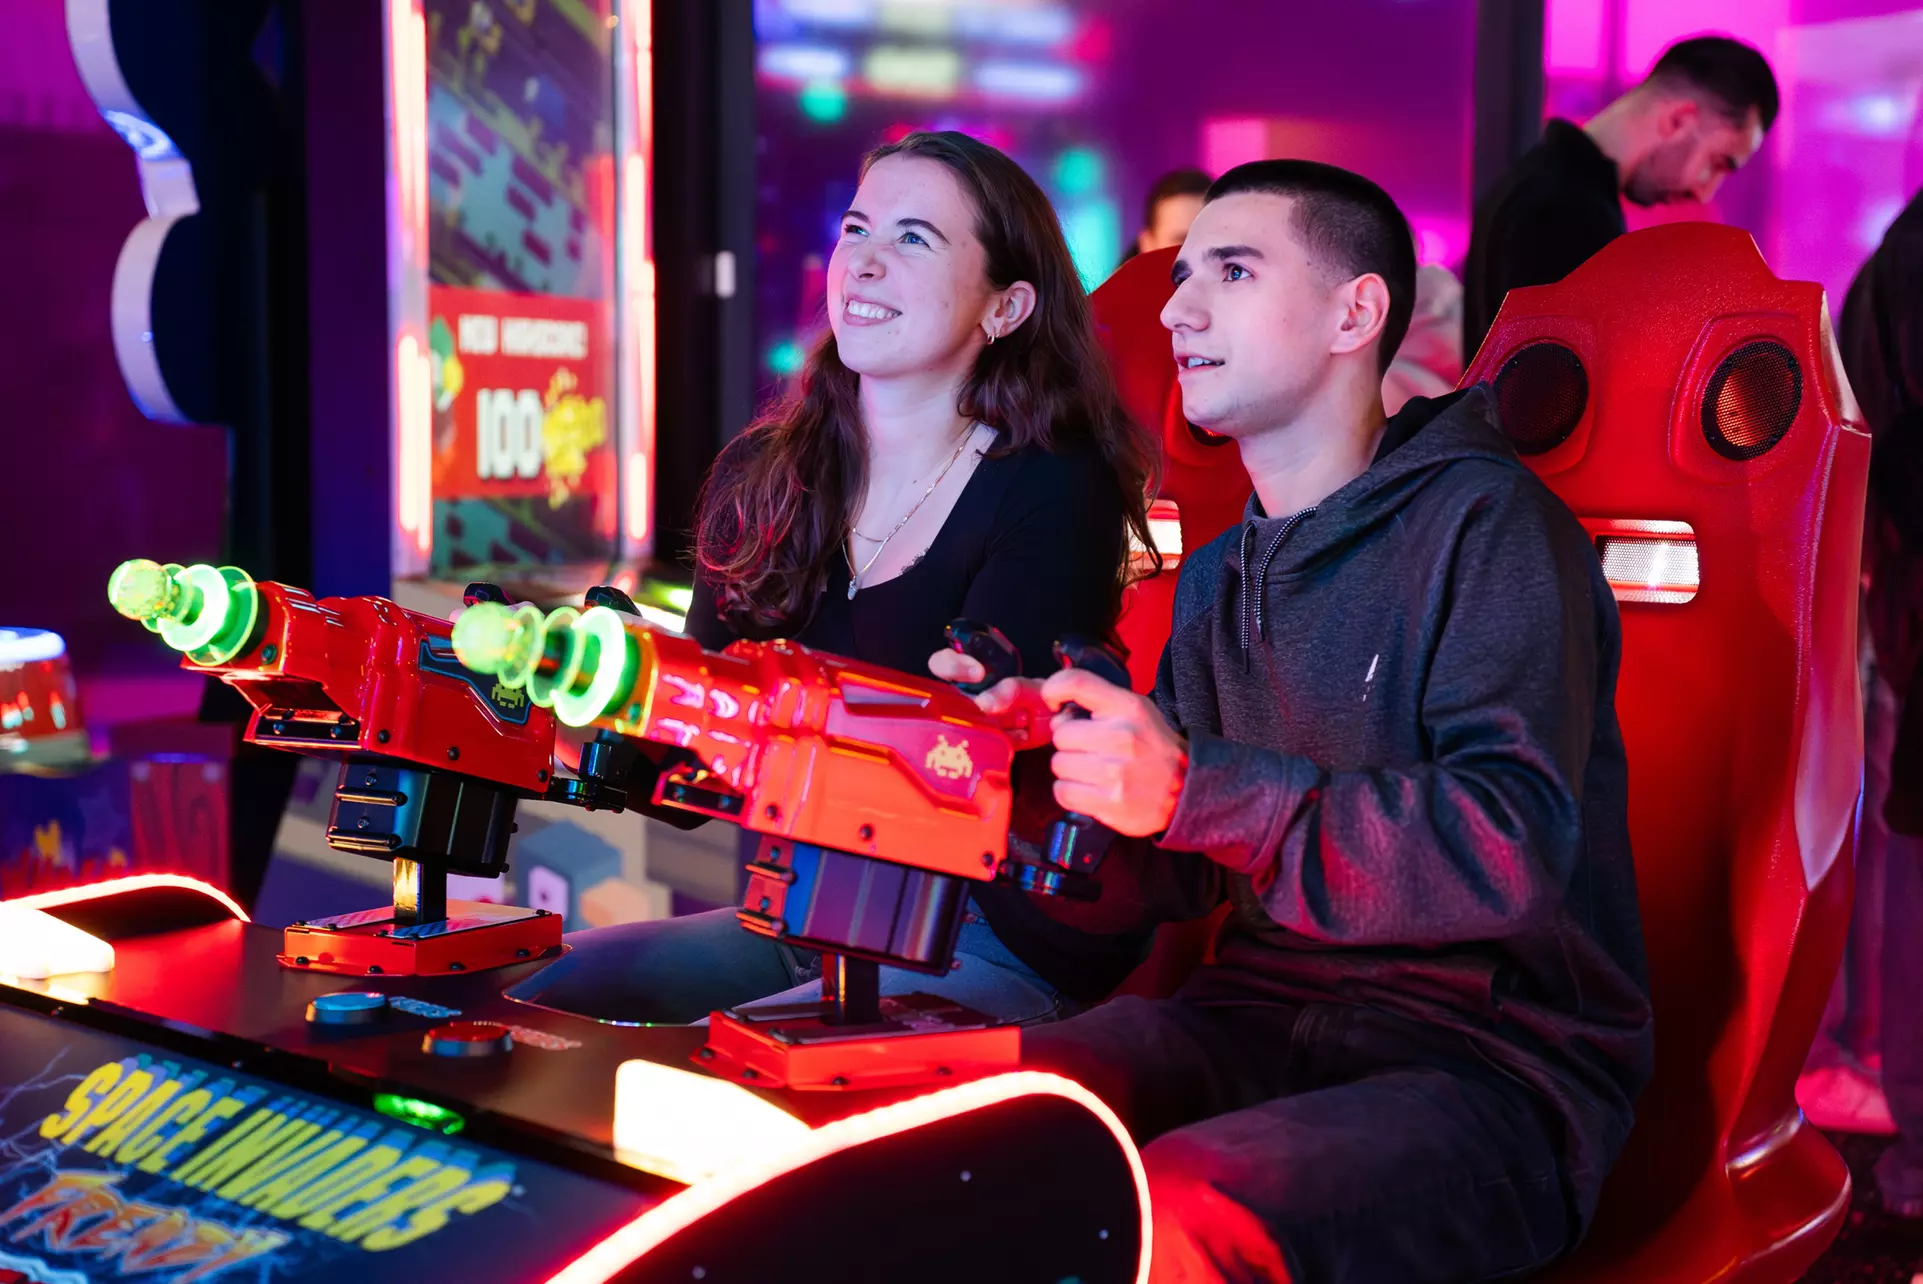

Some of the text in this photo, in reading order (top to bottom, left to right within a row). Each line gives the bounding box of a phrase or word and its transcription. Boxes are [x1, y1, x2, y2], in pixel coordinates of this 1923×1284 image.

[477, 388, 541, 479] 100
[39, 1061, 512, 1251] SPACE INVADERS
